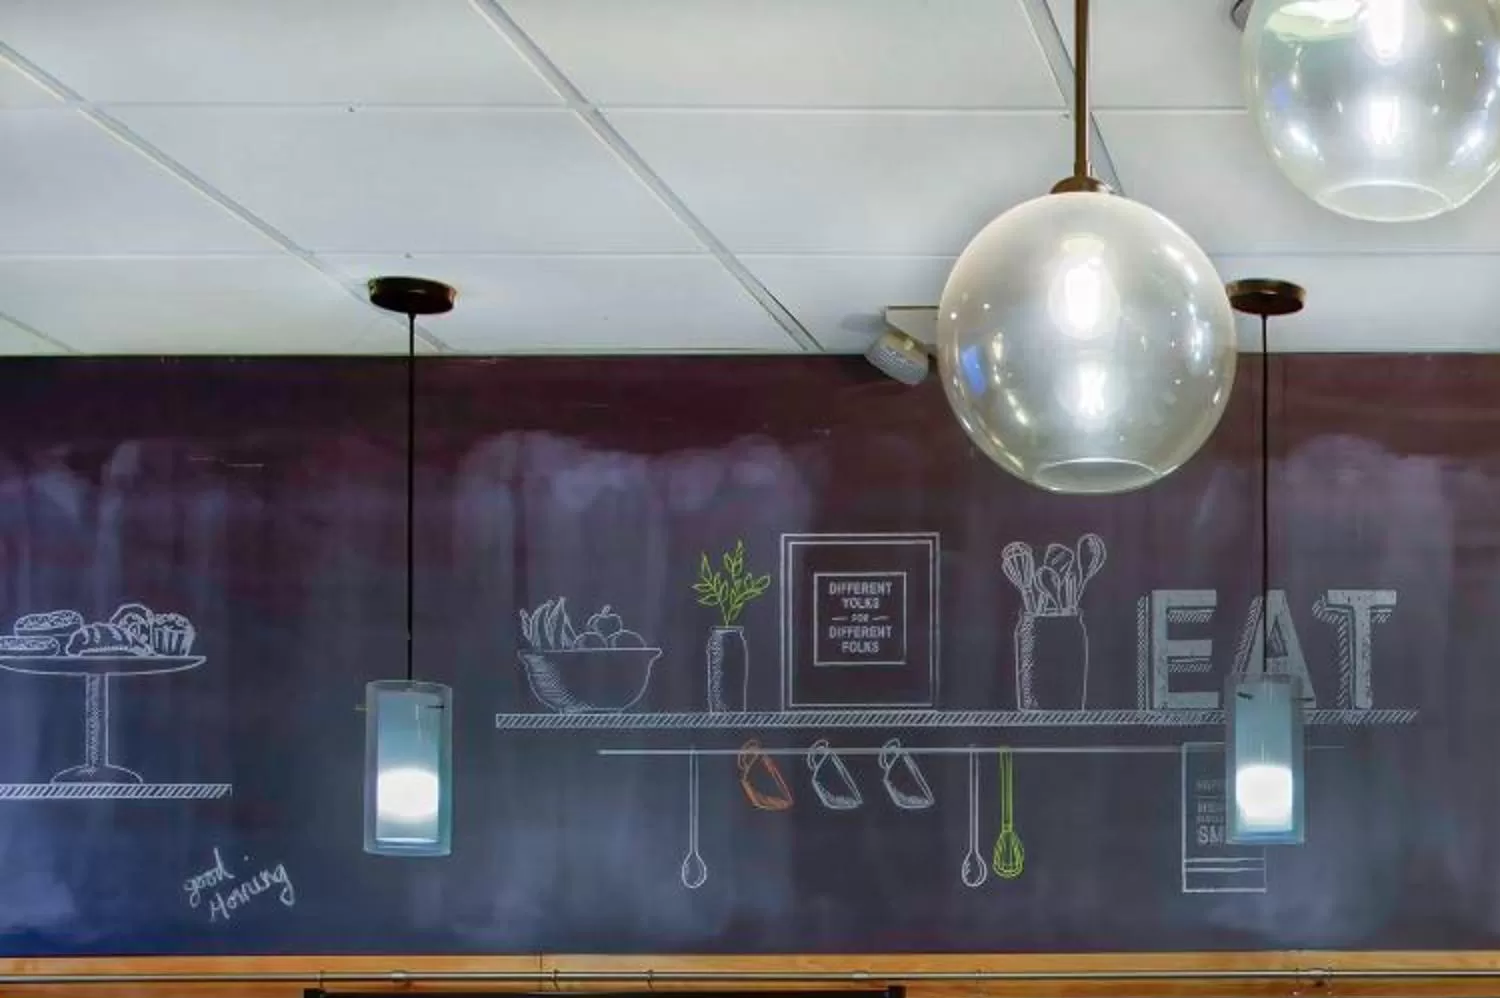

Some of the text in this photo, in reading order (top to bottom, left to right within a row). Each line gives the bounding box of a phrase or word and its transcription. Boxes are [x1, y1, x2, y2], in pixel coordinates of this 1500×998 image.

[829, 581, 893, 595] DIFFERENT
[841, 597, 880, 610] YOLKS
[829, 625, 893, 639] DIFFERENT
[841, 641, 880, 654] FOLKS
[1138, 589, 1396, 709] EAT
[183, 847, 235, 908] good
